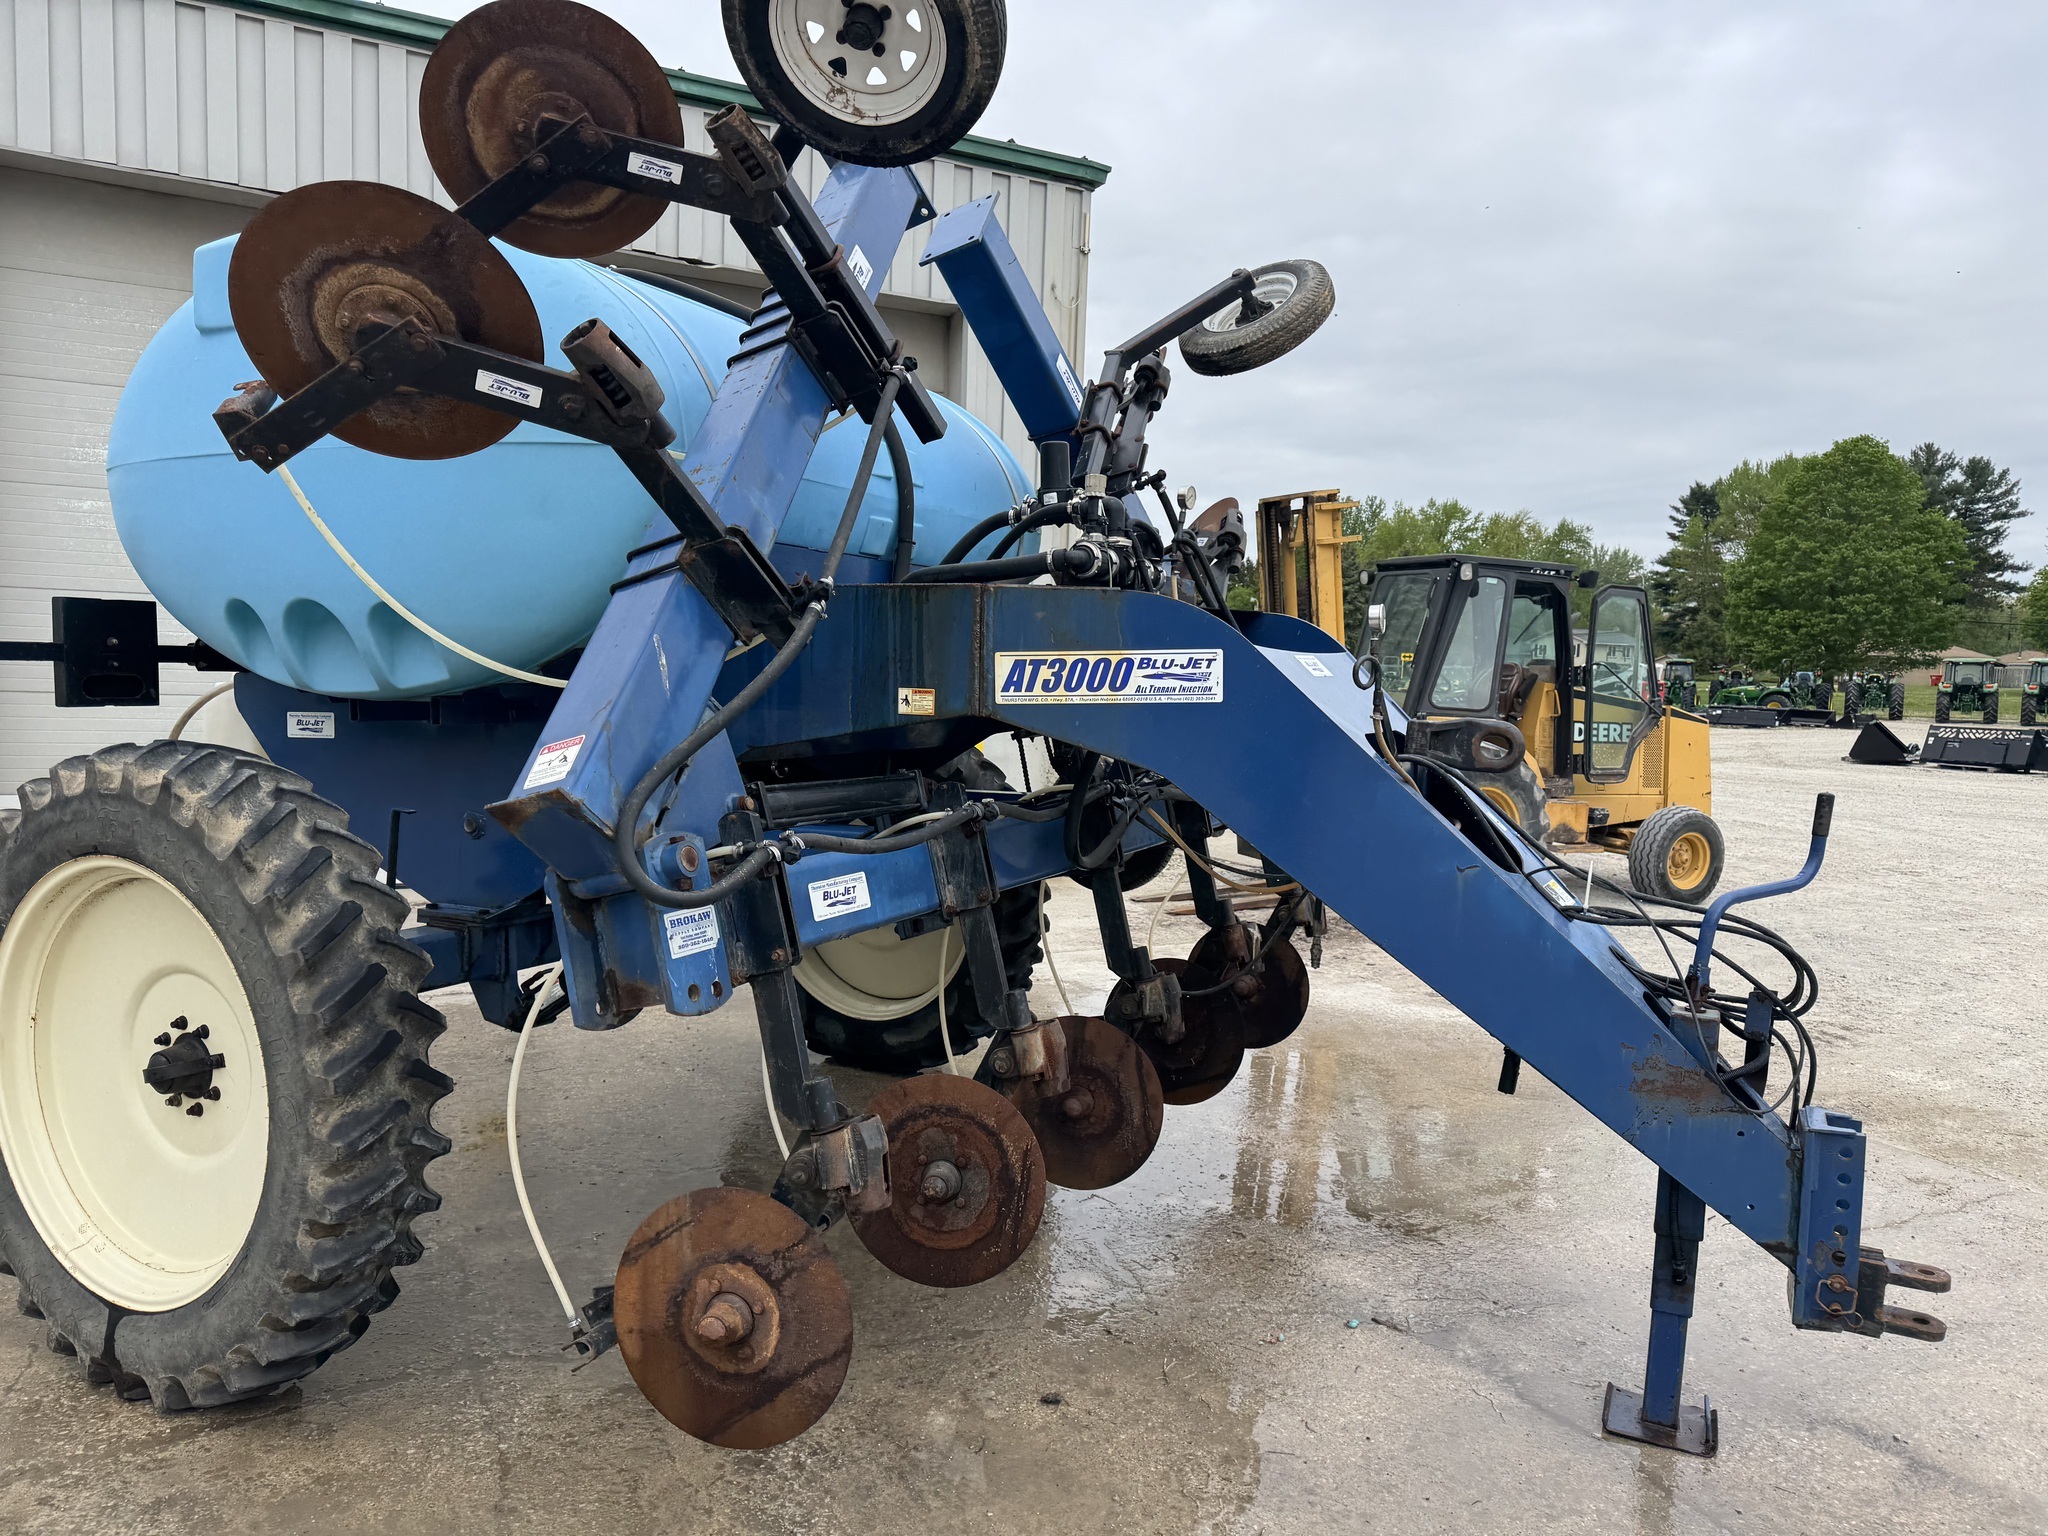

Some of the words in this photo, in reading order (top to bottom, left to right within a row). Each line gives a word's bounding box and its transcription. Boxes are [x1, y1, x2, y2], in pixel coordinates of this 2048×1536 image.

[638, 164, 673, 177] BLU-JET
[488, 383, 530, 400] BLU-JET
[1137, 657, 1217, 670] BLU-JET
[1000, 657, 1135, 693] AT3000
[1135, 685, 1147, 694] ALL
[1148, 685, 1177, 694] TERRAIN
[1178, 684, 1213, 693] INJECTION
[296, 718, 325, 727] BLU-JET
[549, 739, 580, 752] DANGER
[823, 885, 857, 901] BLU-JET
[669, 910, 711, 929] BROKAW
